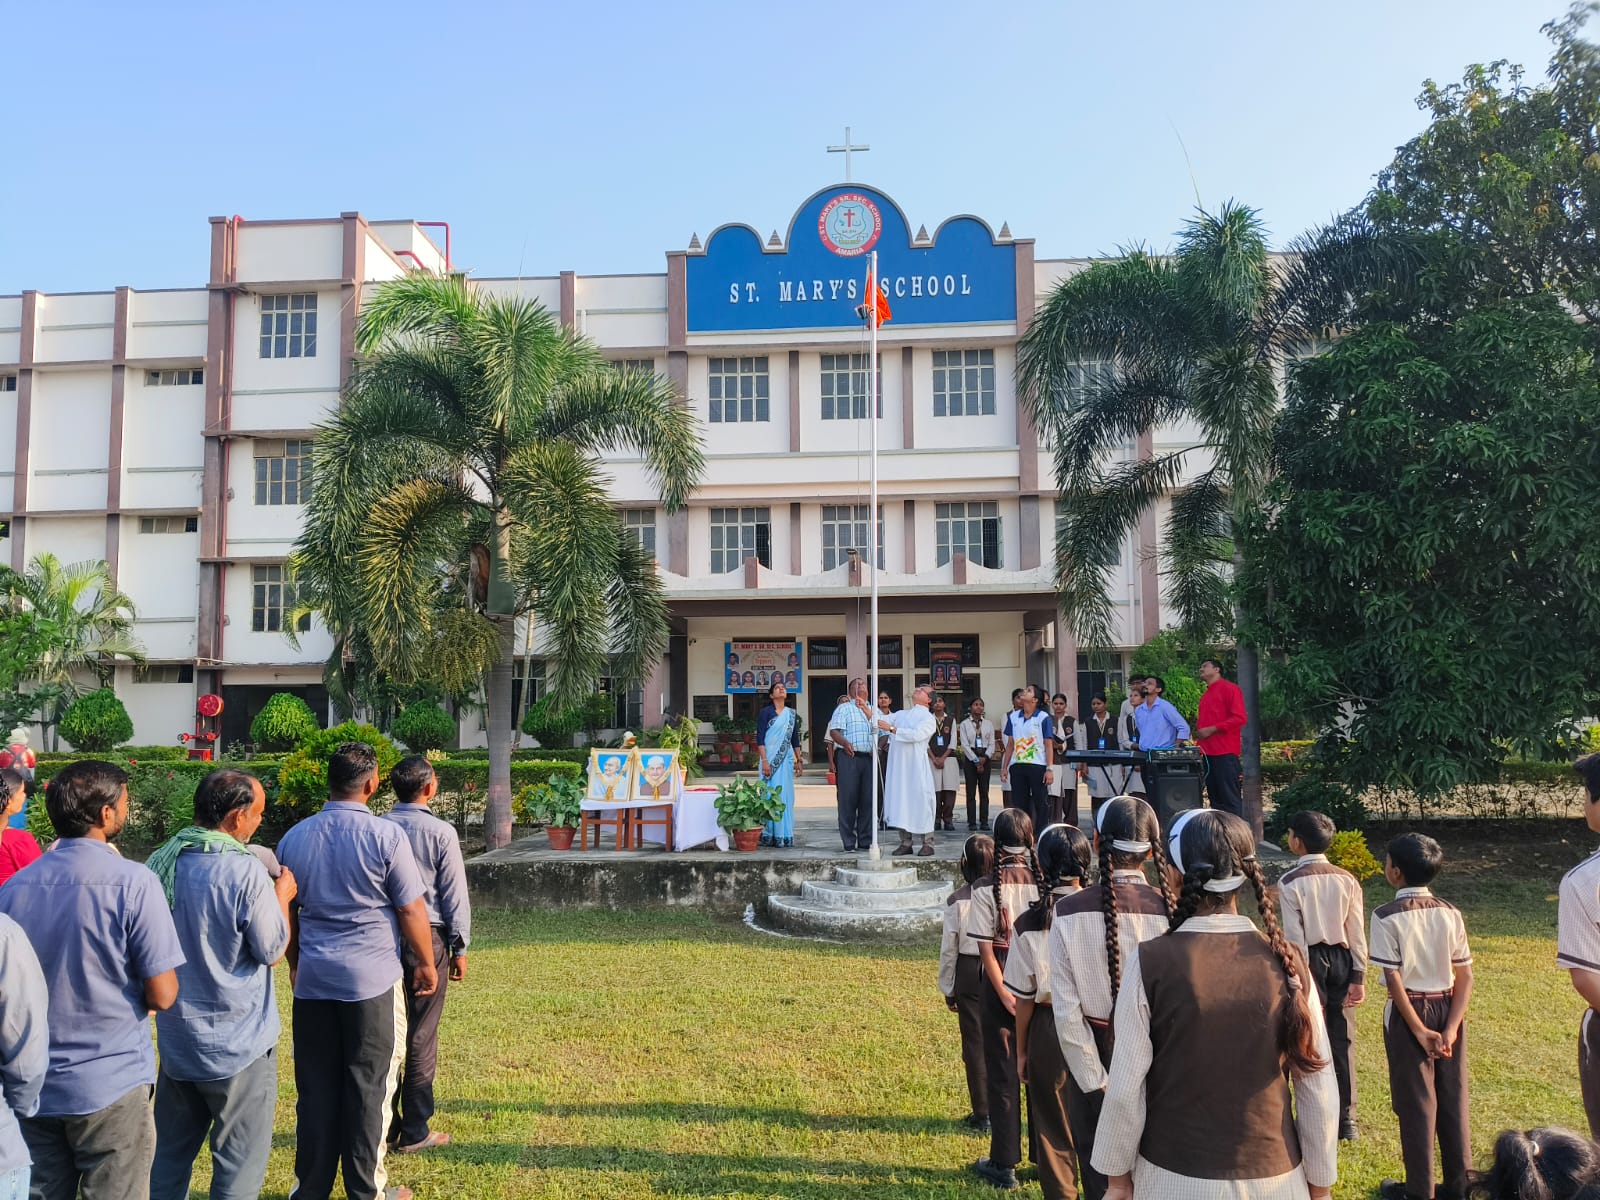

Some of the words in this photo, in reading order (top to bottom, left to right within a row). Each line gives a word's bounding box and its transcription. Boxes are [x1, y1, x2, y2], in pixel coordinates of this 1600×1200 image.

[819, 199, 838, 222] MARY'S
[869, 204, 881, 231] SCHOOL
[729, 281, 760, 304] ST.
[779, 278, 857, 303] MARY'S
[881, 273, 971, 299] SCHOOL
